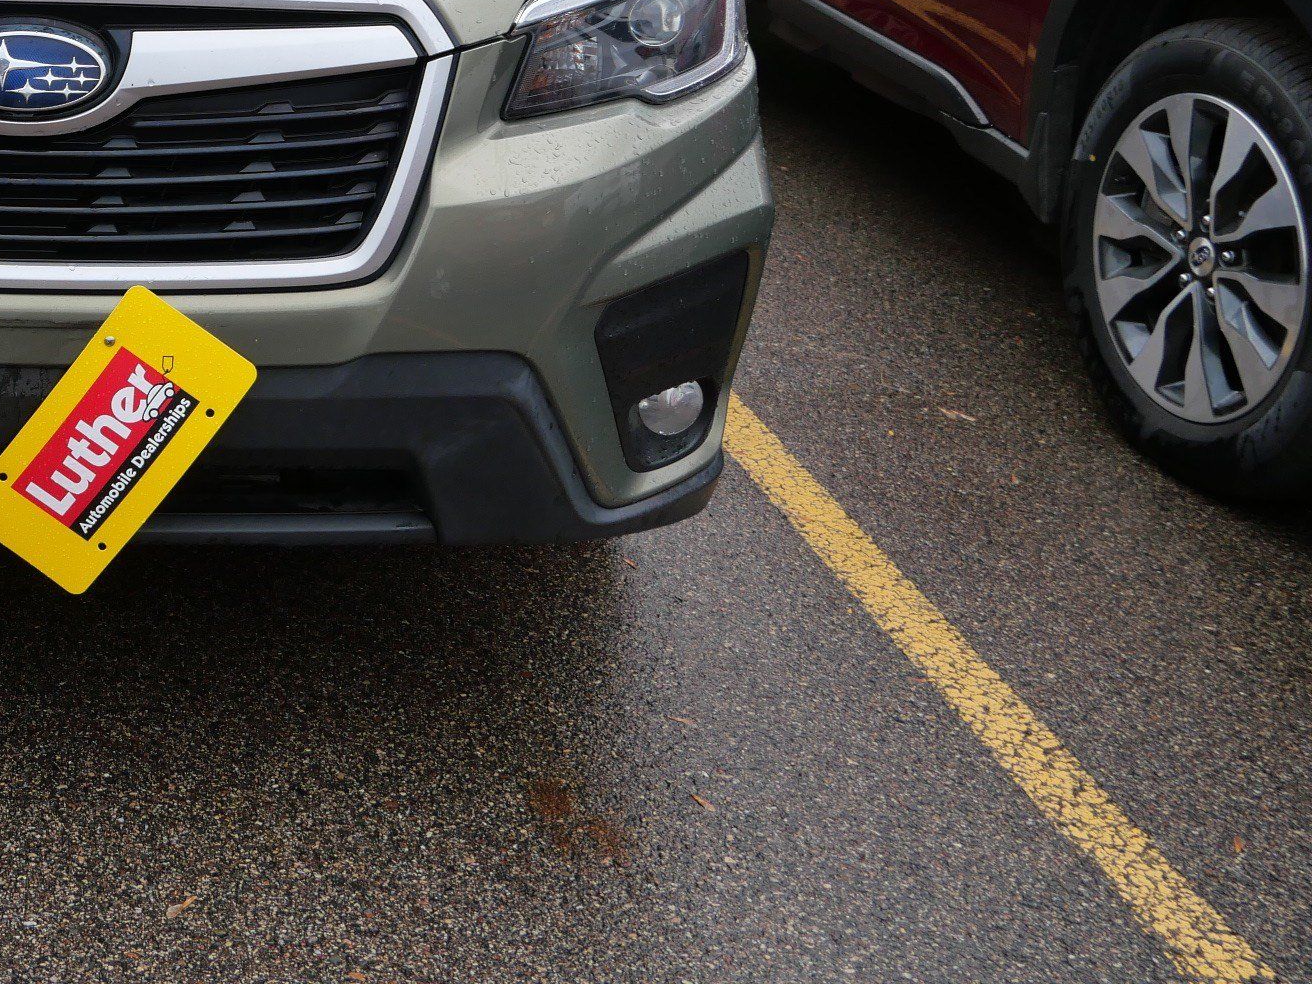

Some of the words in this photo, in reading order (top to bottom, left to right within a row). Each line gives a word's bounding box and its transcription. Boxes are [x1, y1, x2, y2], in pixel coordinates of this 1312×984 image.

[25, 362, 154, 516] Luther
[79, 466, 137, 534] Automobile
[130, 396, 191, 469] Dealerships
